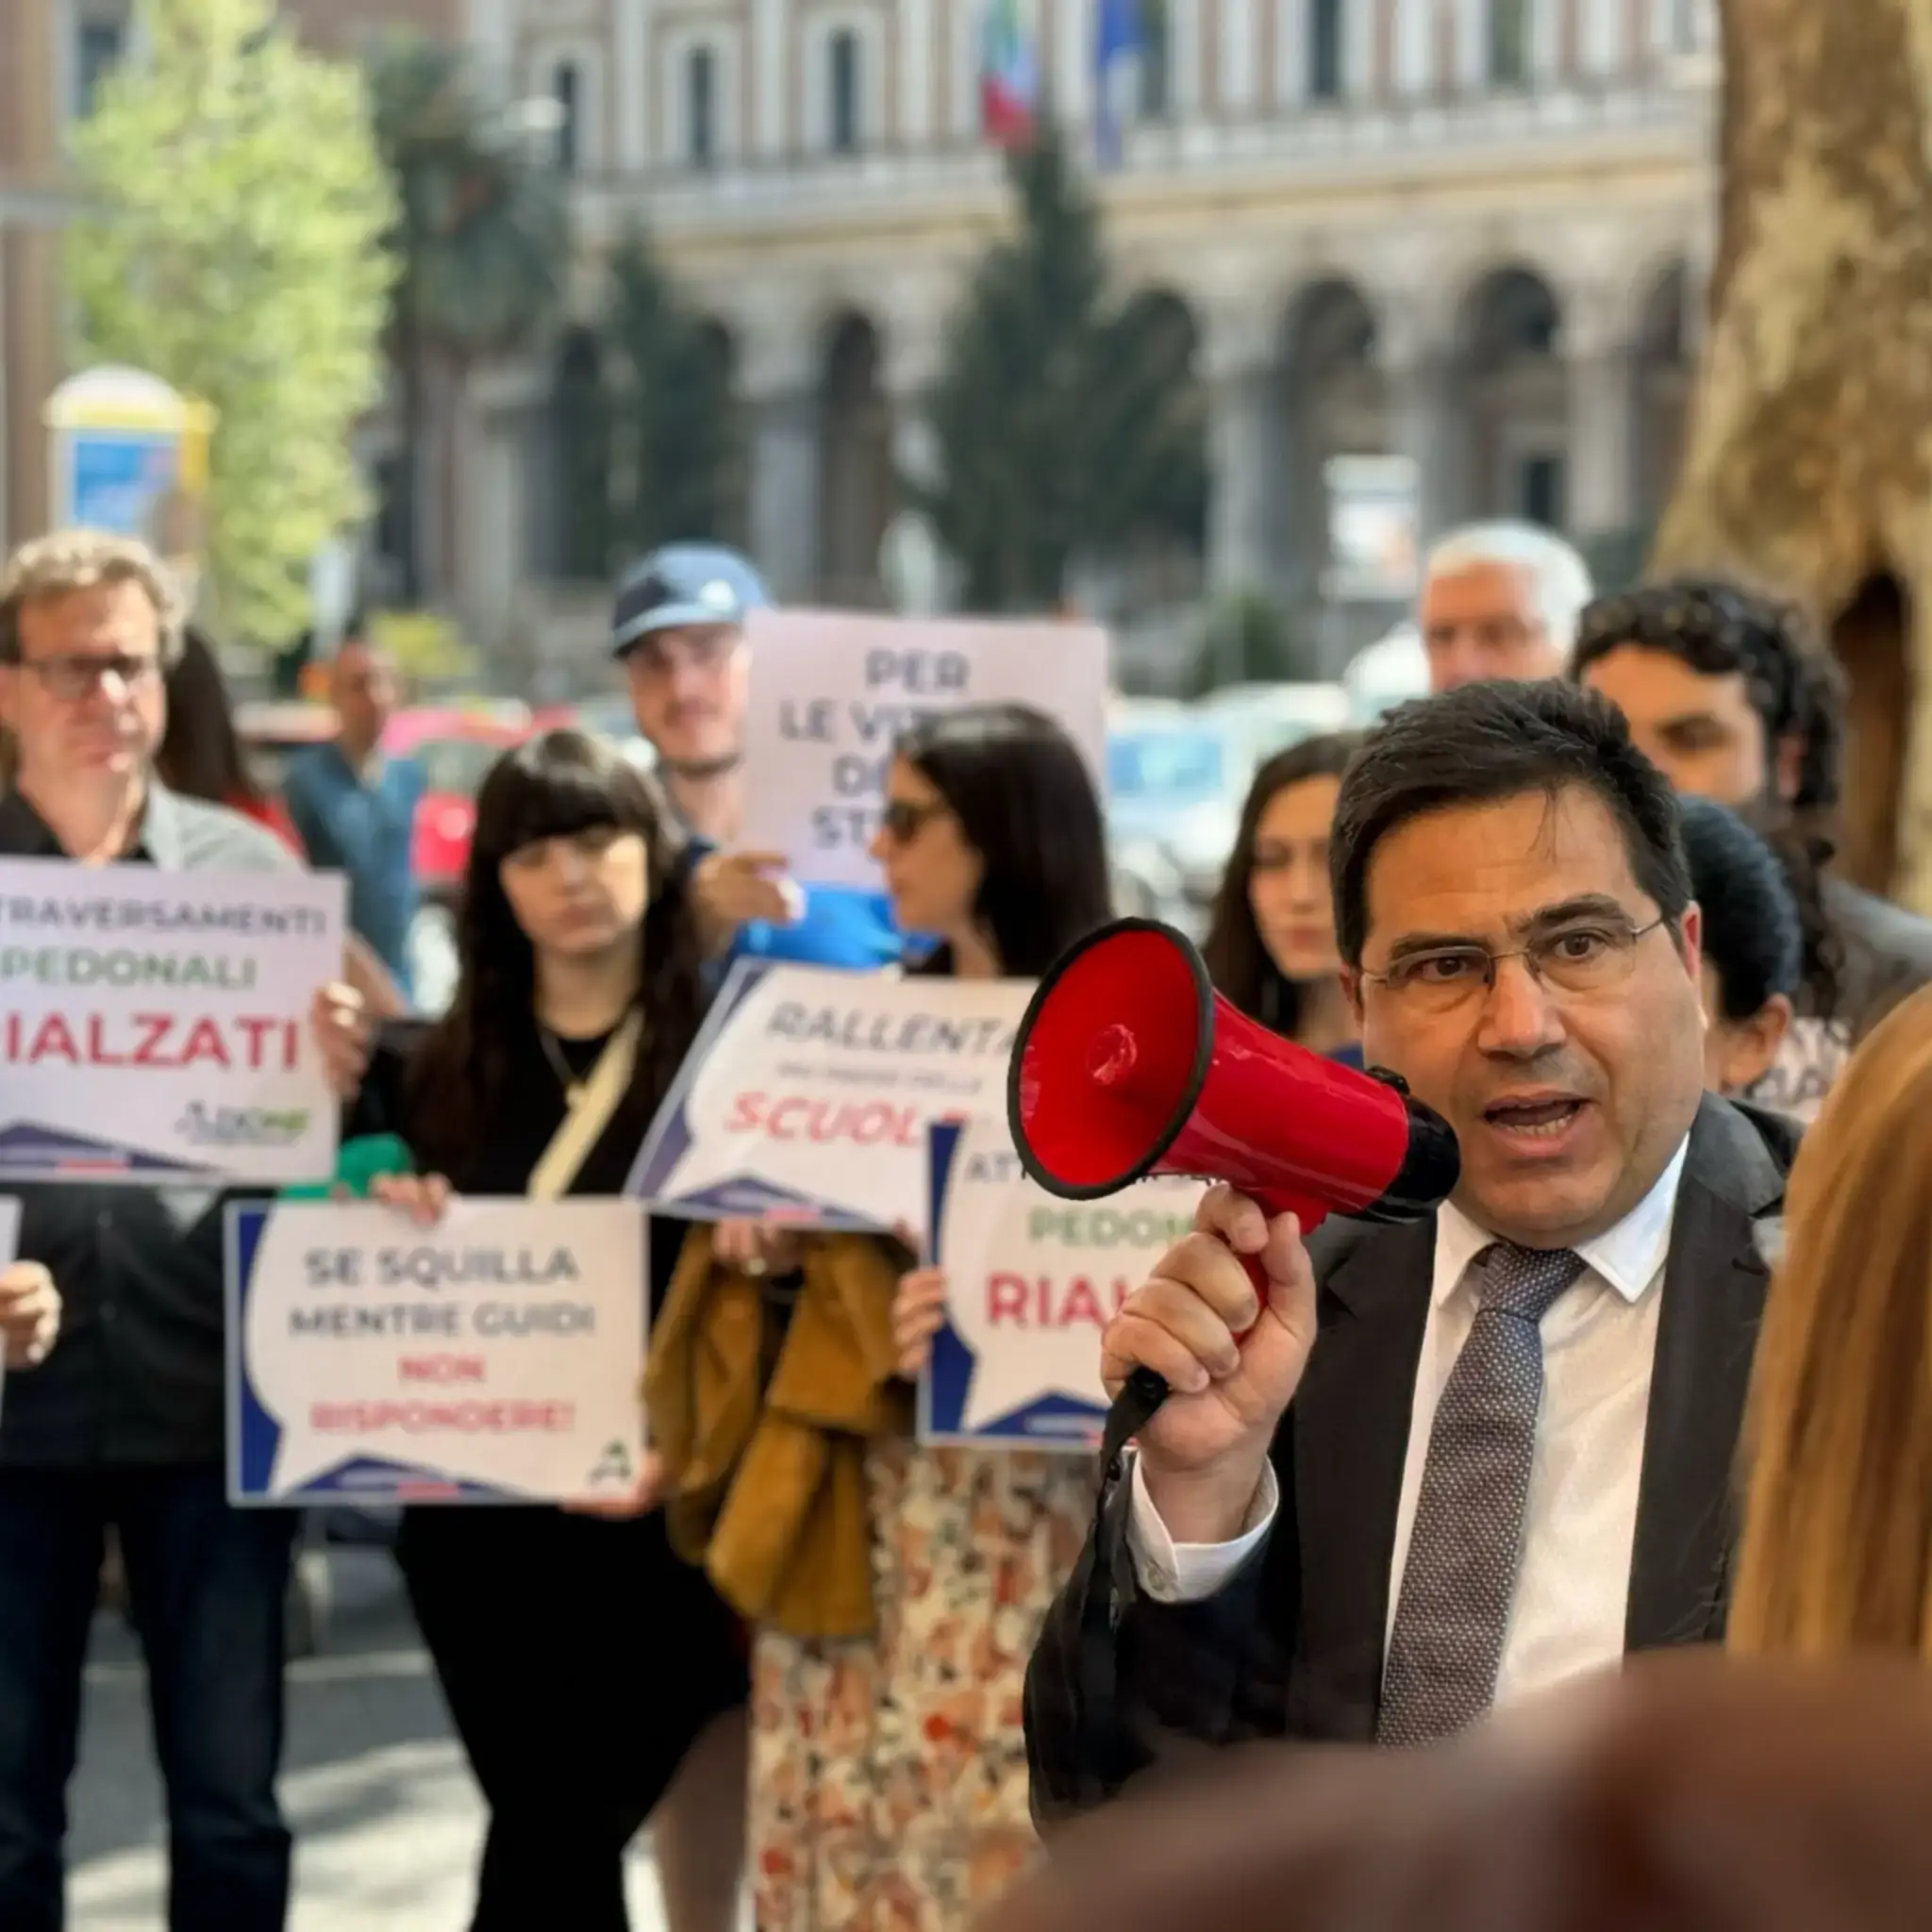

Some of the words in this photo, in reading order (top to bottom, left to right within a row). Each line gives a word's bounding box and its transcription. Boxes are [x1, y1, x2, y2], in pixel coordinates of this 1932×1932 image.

[865, 649, 970, 693] PER
[779, 700, 834, 742] LE
[0, 896, 327, 935] RAVERSAMENTI
[2, 947, 258, 989] PEDONALI
[724, 1091, 970, 1145] SCUOL
[304, 1246, 362, 1287] SE
[377, 1246, 581, 1291] SQUILLA
[288, 1301, 458, 1340] MENTRE
[472, 1301, 596, 1339] GUIDI
[397, 1353, 486, 1383] NON
